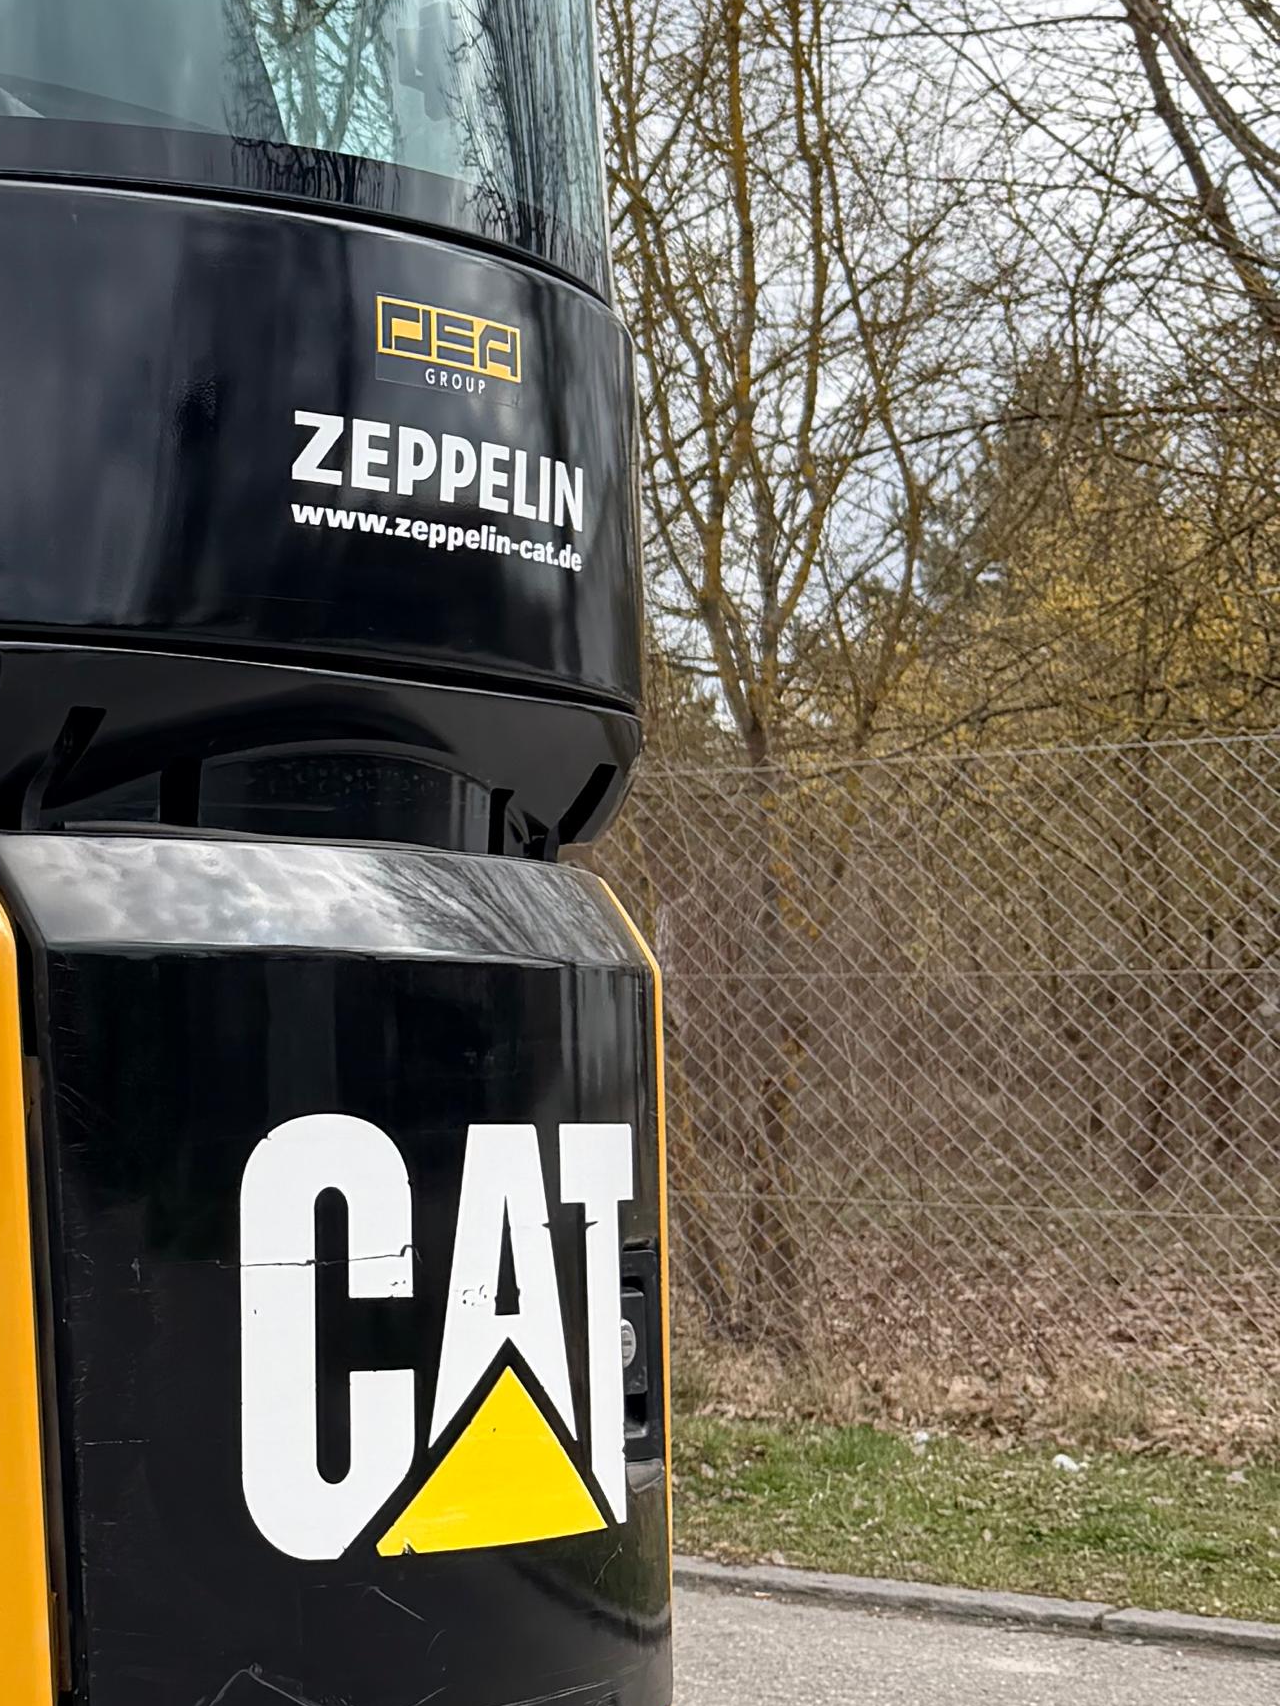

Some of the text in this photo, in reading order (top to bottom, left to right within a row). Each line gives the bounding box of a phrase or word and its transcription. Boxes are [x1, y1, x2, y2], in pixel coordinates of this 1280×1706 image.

[425, 368, 486, 394] GROUP
[291, 410, 583, 533] ZEPPELIN
[290, 503, 582, 573] www.zeppelin-cat.de
[240, 1113, 634, 1561] CAT
